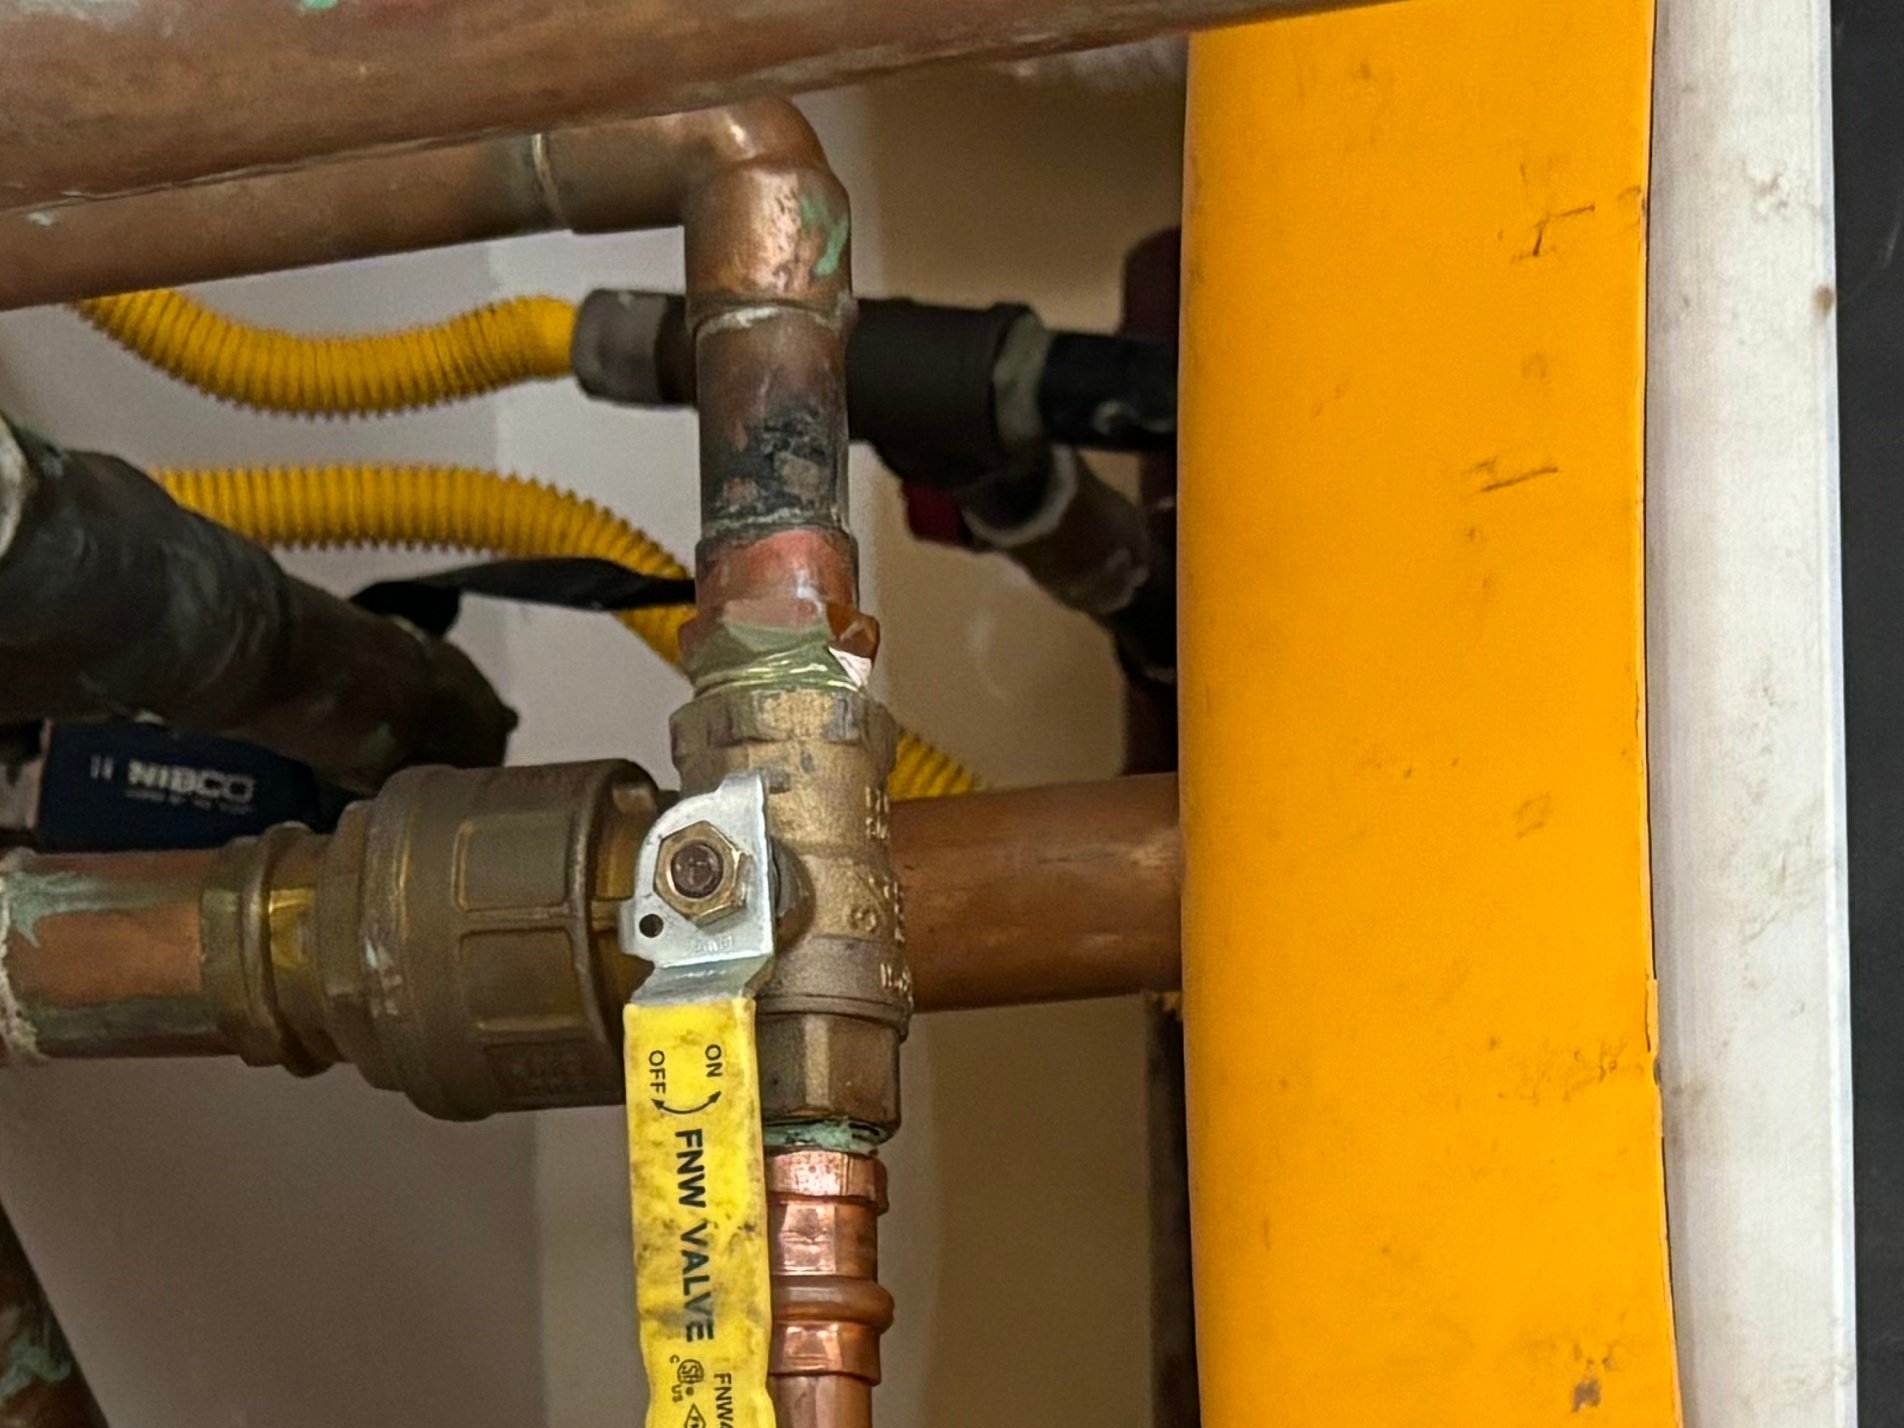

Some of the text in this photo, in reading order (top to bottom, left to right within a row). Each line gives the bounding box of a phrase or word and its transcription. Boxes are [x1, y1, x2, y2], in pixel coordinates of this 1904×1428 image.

[648, 1049, 667, 1095] OFF
[704, 1043, 722, 1078] ON
[674, 1128, 714, 1343] FNW VALVE
